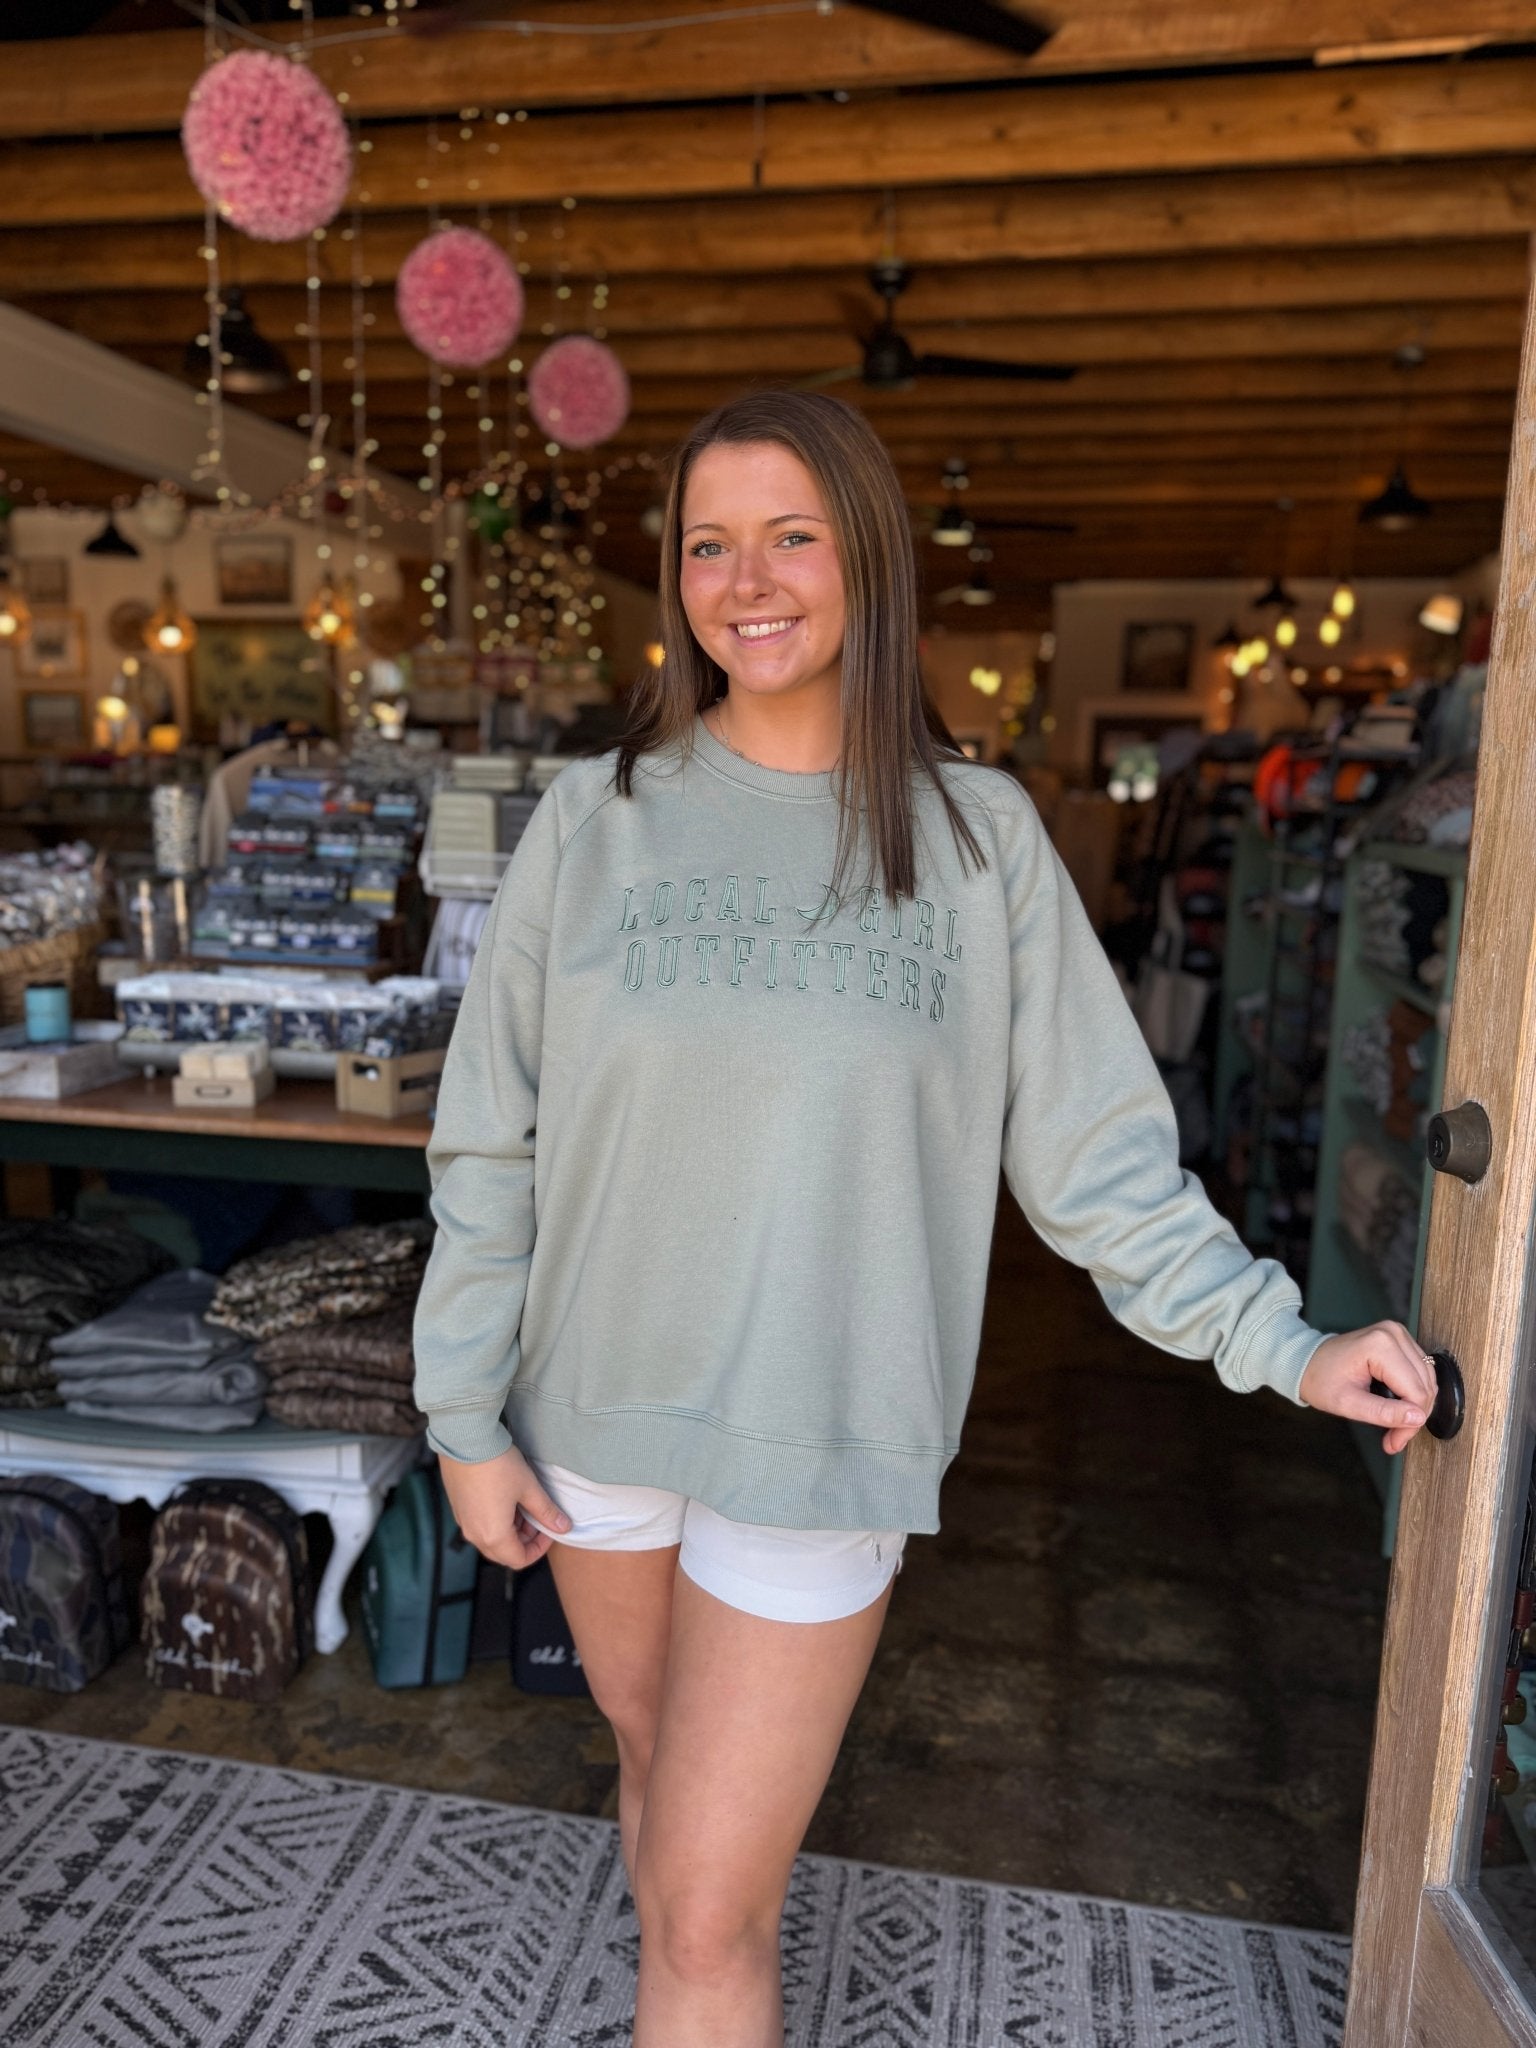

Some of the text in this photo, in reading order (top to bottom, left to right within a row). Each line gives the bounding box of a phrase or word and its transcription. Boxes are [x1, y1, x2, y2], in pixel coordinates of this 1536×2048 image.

[618, 875, 962, 962] LOCAL GIRL
[623, 934, 946, 1023] OUTFITTERS
